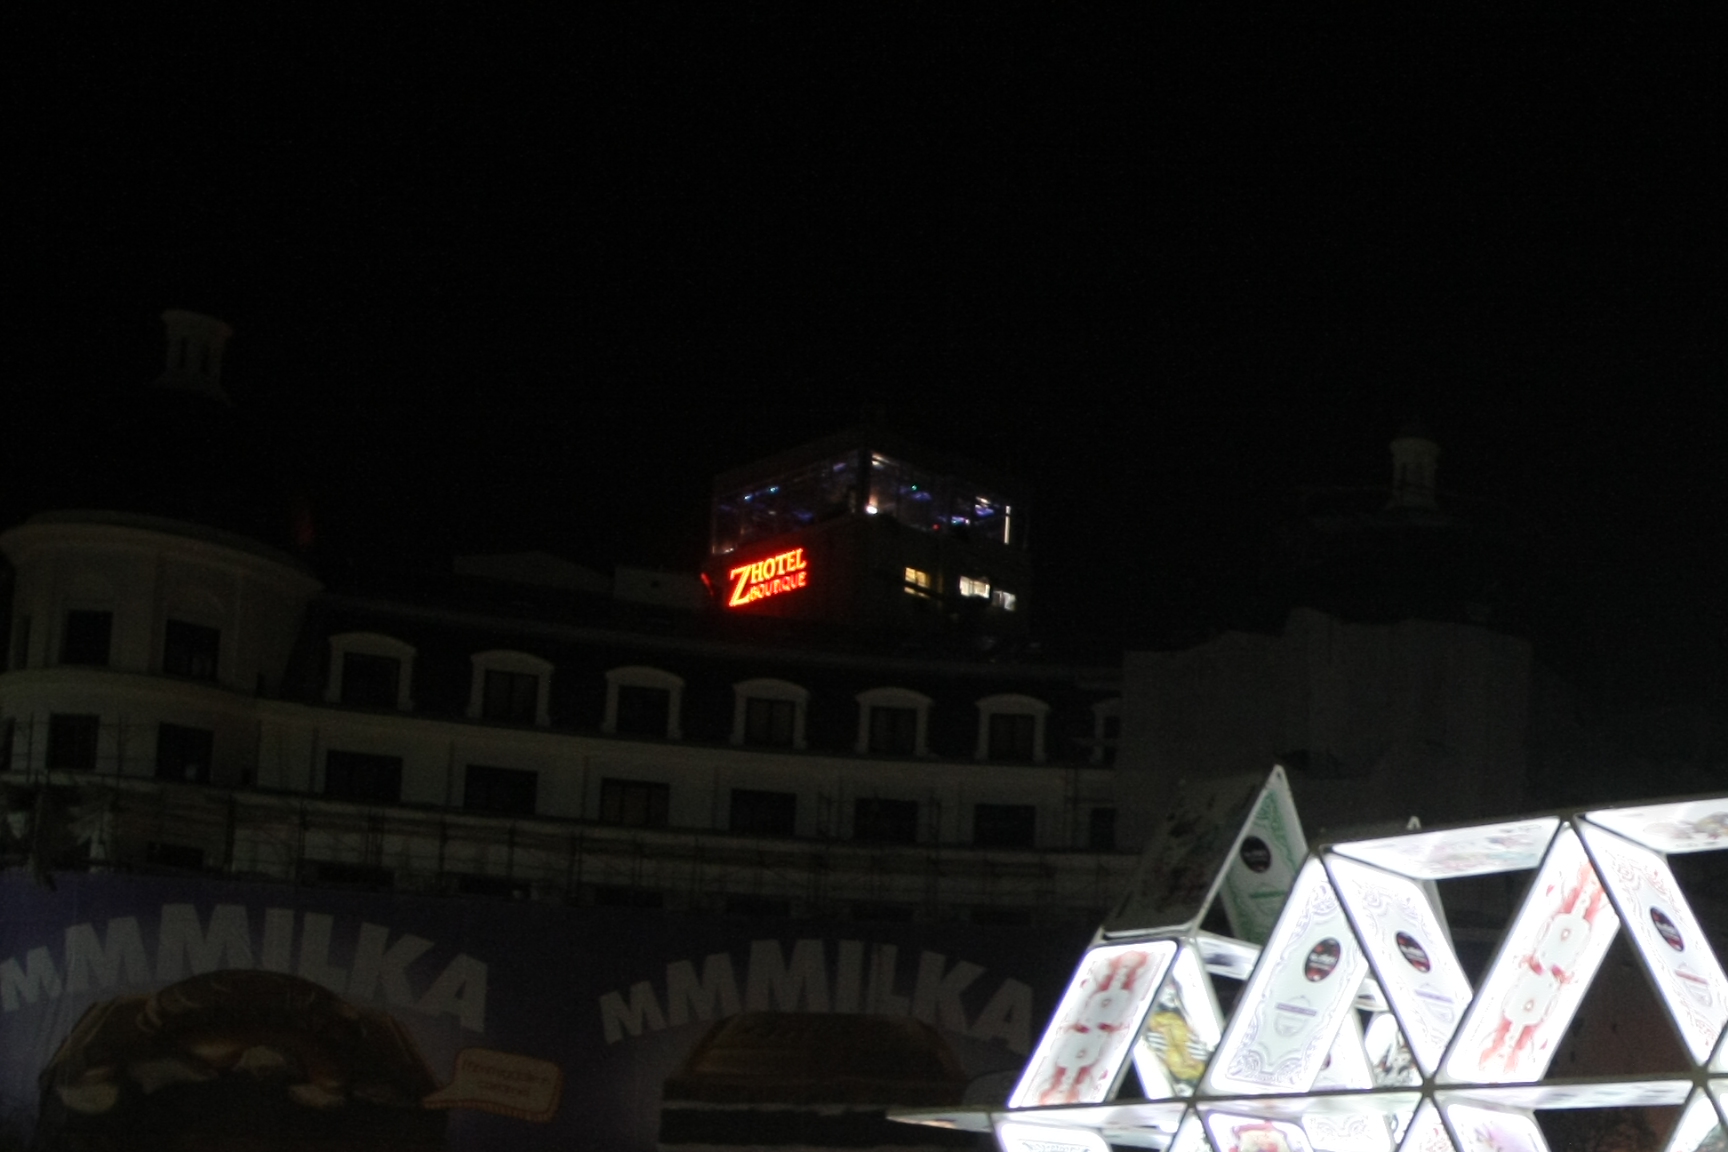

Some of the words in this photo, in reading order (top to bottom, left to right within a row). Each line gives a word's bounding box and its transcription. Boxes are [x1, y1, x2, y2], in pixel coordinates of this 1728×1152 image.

[750, 571, 807, 601] BOUTIQUE
[0, 902, 489, 1034] MMMILKA
[600, 937, 1034, 1056] MMMILKA
